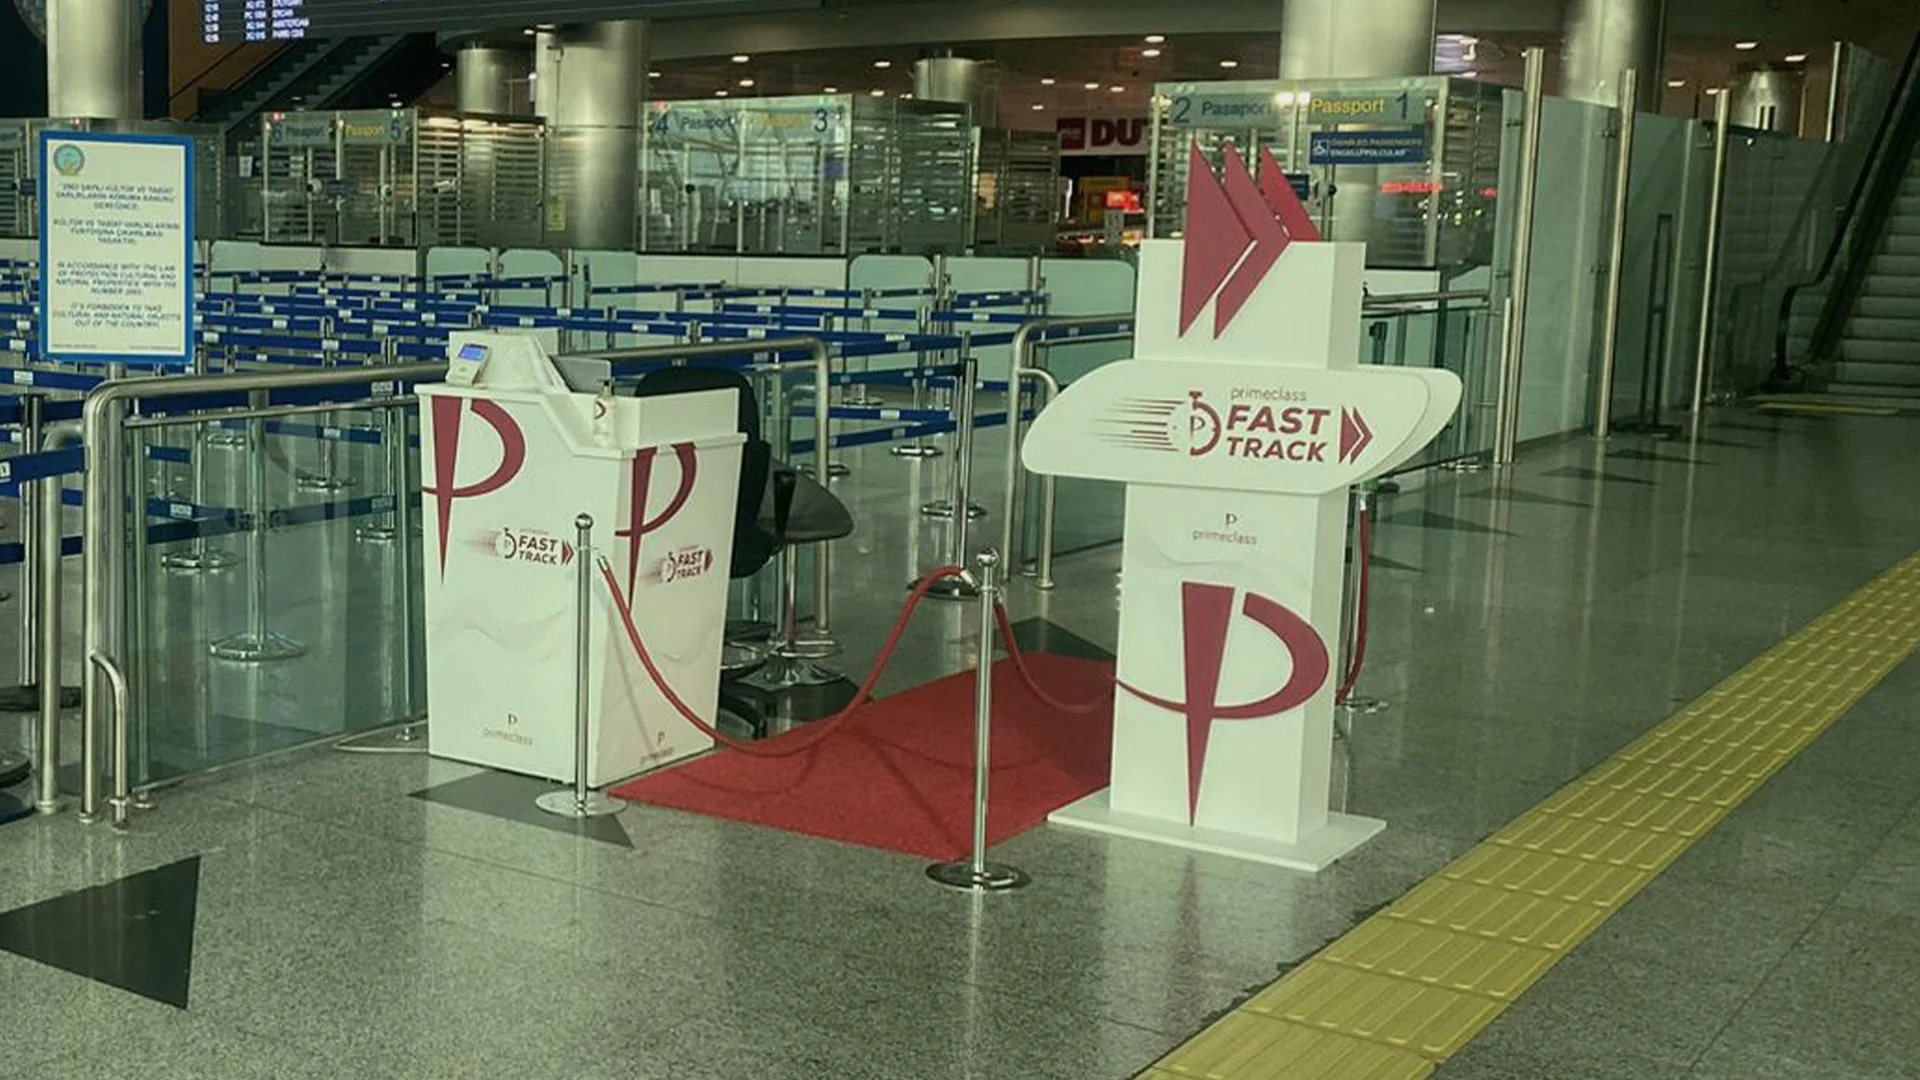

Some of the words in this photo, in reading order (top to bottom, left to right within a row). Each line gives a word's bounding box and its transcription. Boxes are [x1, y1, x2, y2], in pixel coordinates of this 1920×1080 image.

[1172, 96, 1191, 124] 2
[1202, 99, 1272, 119] Passport
[1311, 97, 1385, 116] Passport
[1395, 91, 1409, 119] 1
[813, 107, 828, 132] 3
[1231, 387, 1307, 401] primeclass
[1227, 404, 1331, 436] FAST
[1227, 436, 1328, 464] TRACK
[519, 535, 558, 553] FAST
[1192, 530, 1257, 545] primeclass
[519, 550, 558, 566] TRACK
[678, 550, 704, 565] FAST
